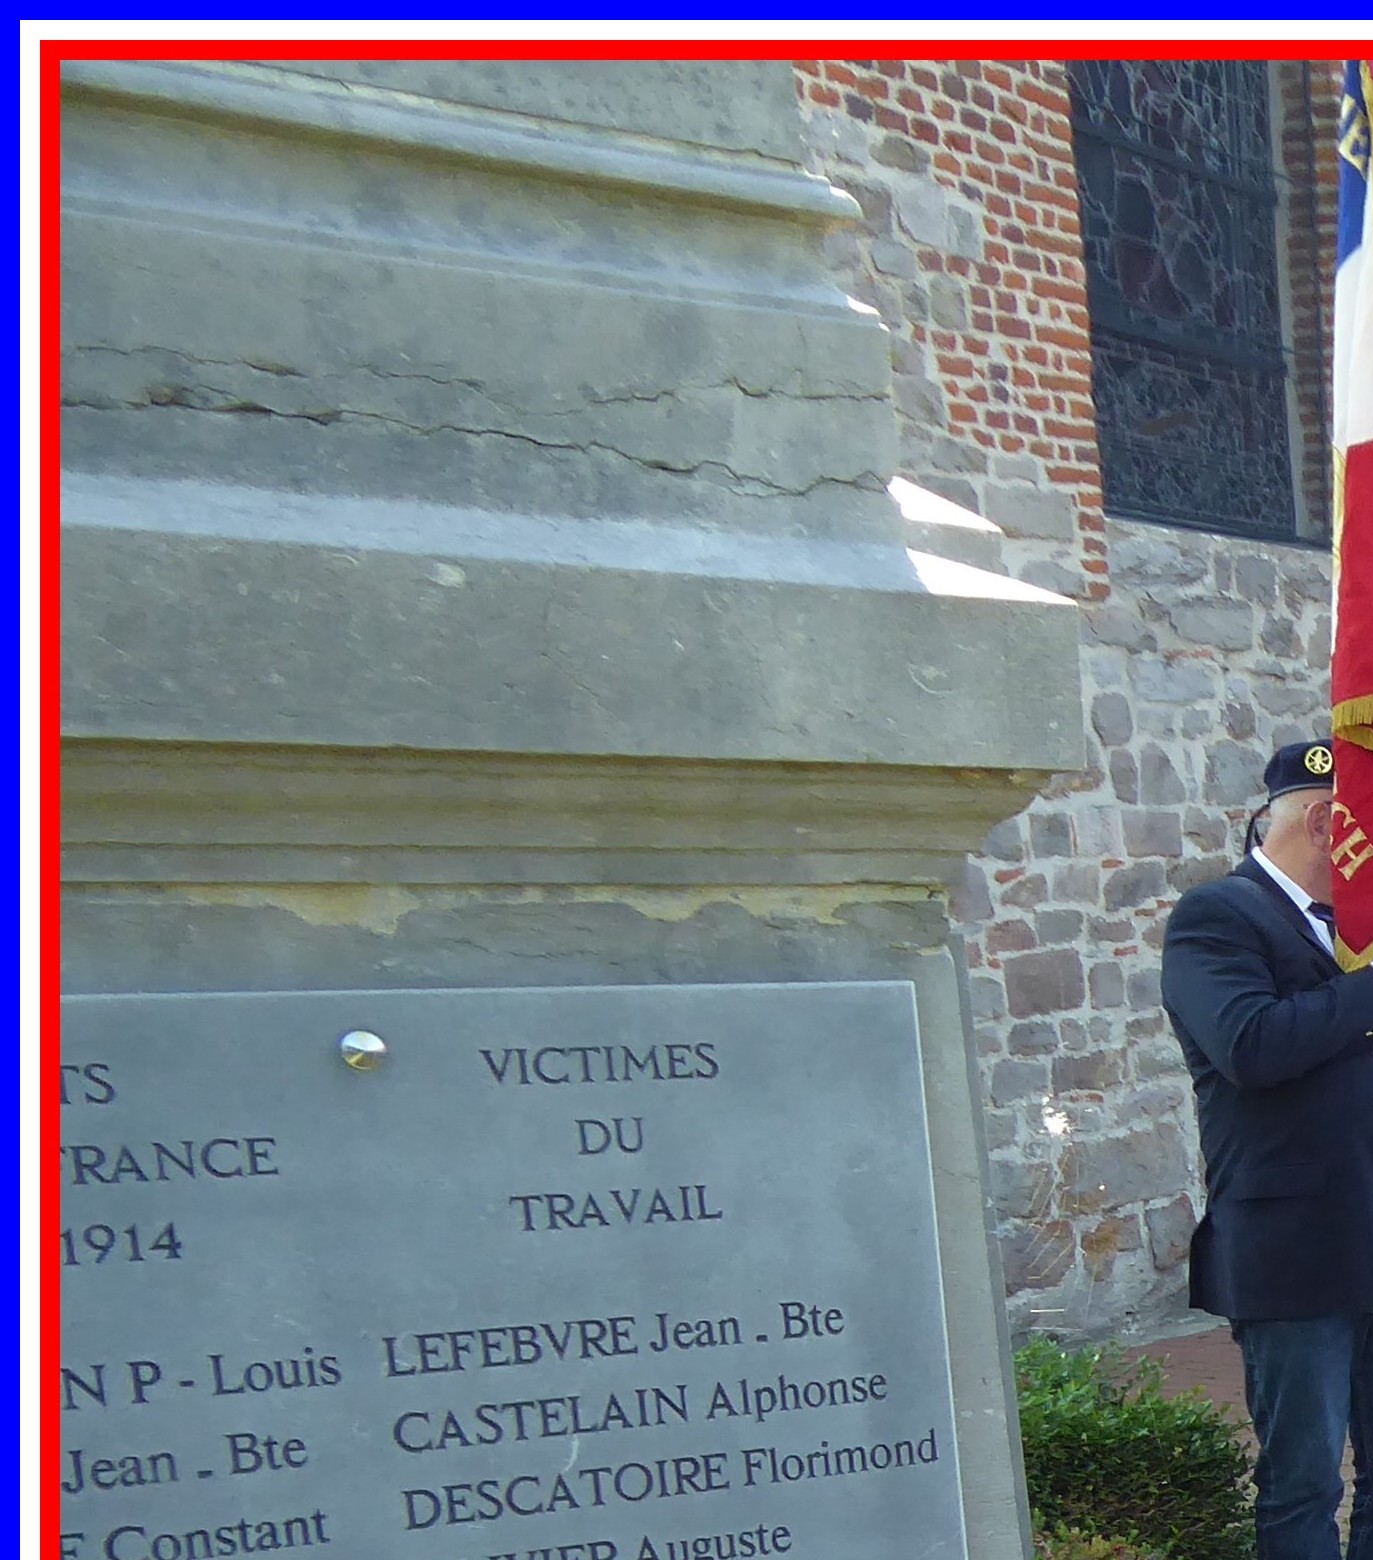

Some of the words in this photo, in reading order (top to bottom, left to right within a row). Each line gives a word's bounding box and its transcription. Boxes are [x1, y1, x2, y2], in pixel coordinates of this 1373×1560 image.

[479, 1043, 719, 1085] VICTIMES
[574, 1117, 644, 1156] DU
[509, 1185, 723, 1231] TRAVAIL
[60, 1221, 182, 1265] 1914
[382, 1316, 637, 1377] LEFEBVRE
[650, 1313, 743, 1352] Jean
[779, 1301, 845, 1340] Bte
[394, 1384, 689, 1453] CASTELAIN
[706, 1374, 888, 1423] Alphonse
[61, 1450, 179, 1494] Jean
[222, 1432, 309, 1475] Bte
[403, 1453, 730, 1530] DESCATOIRE
[743, 1428, 939, 1487] Florimond
